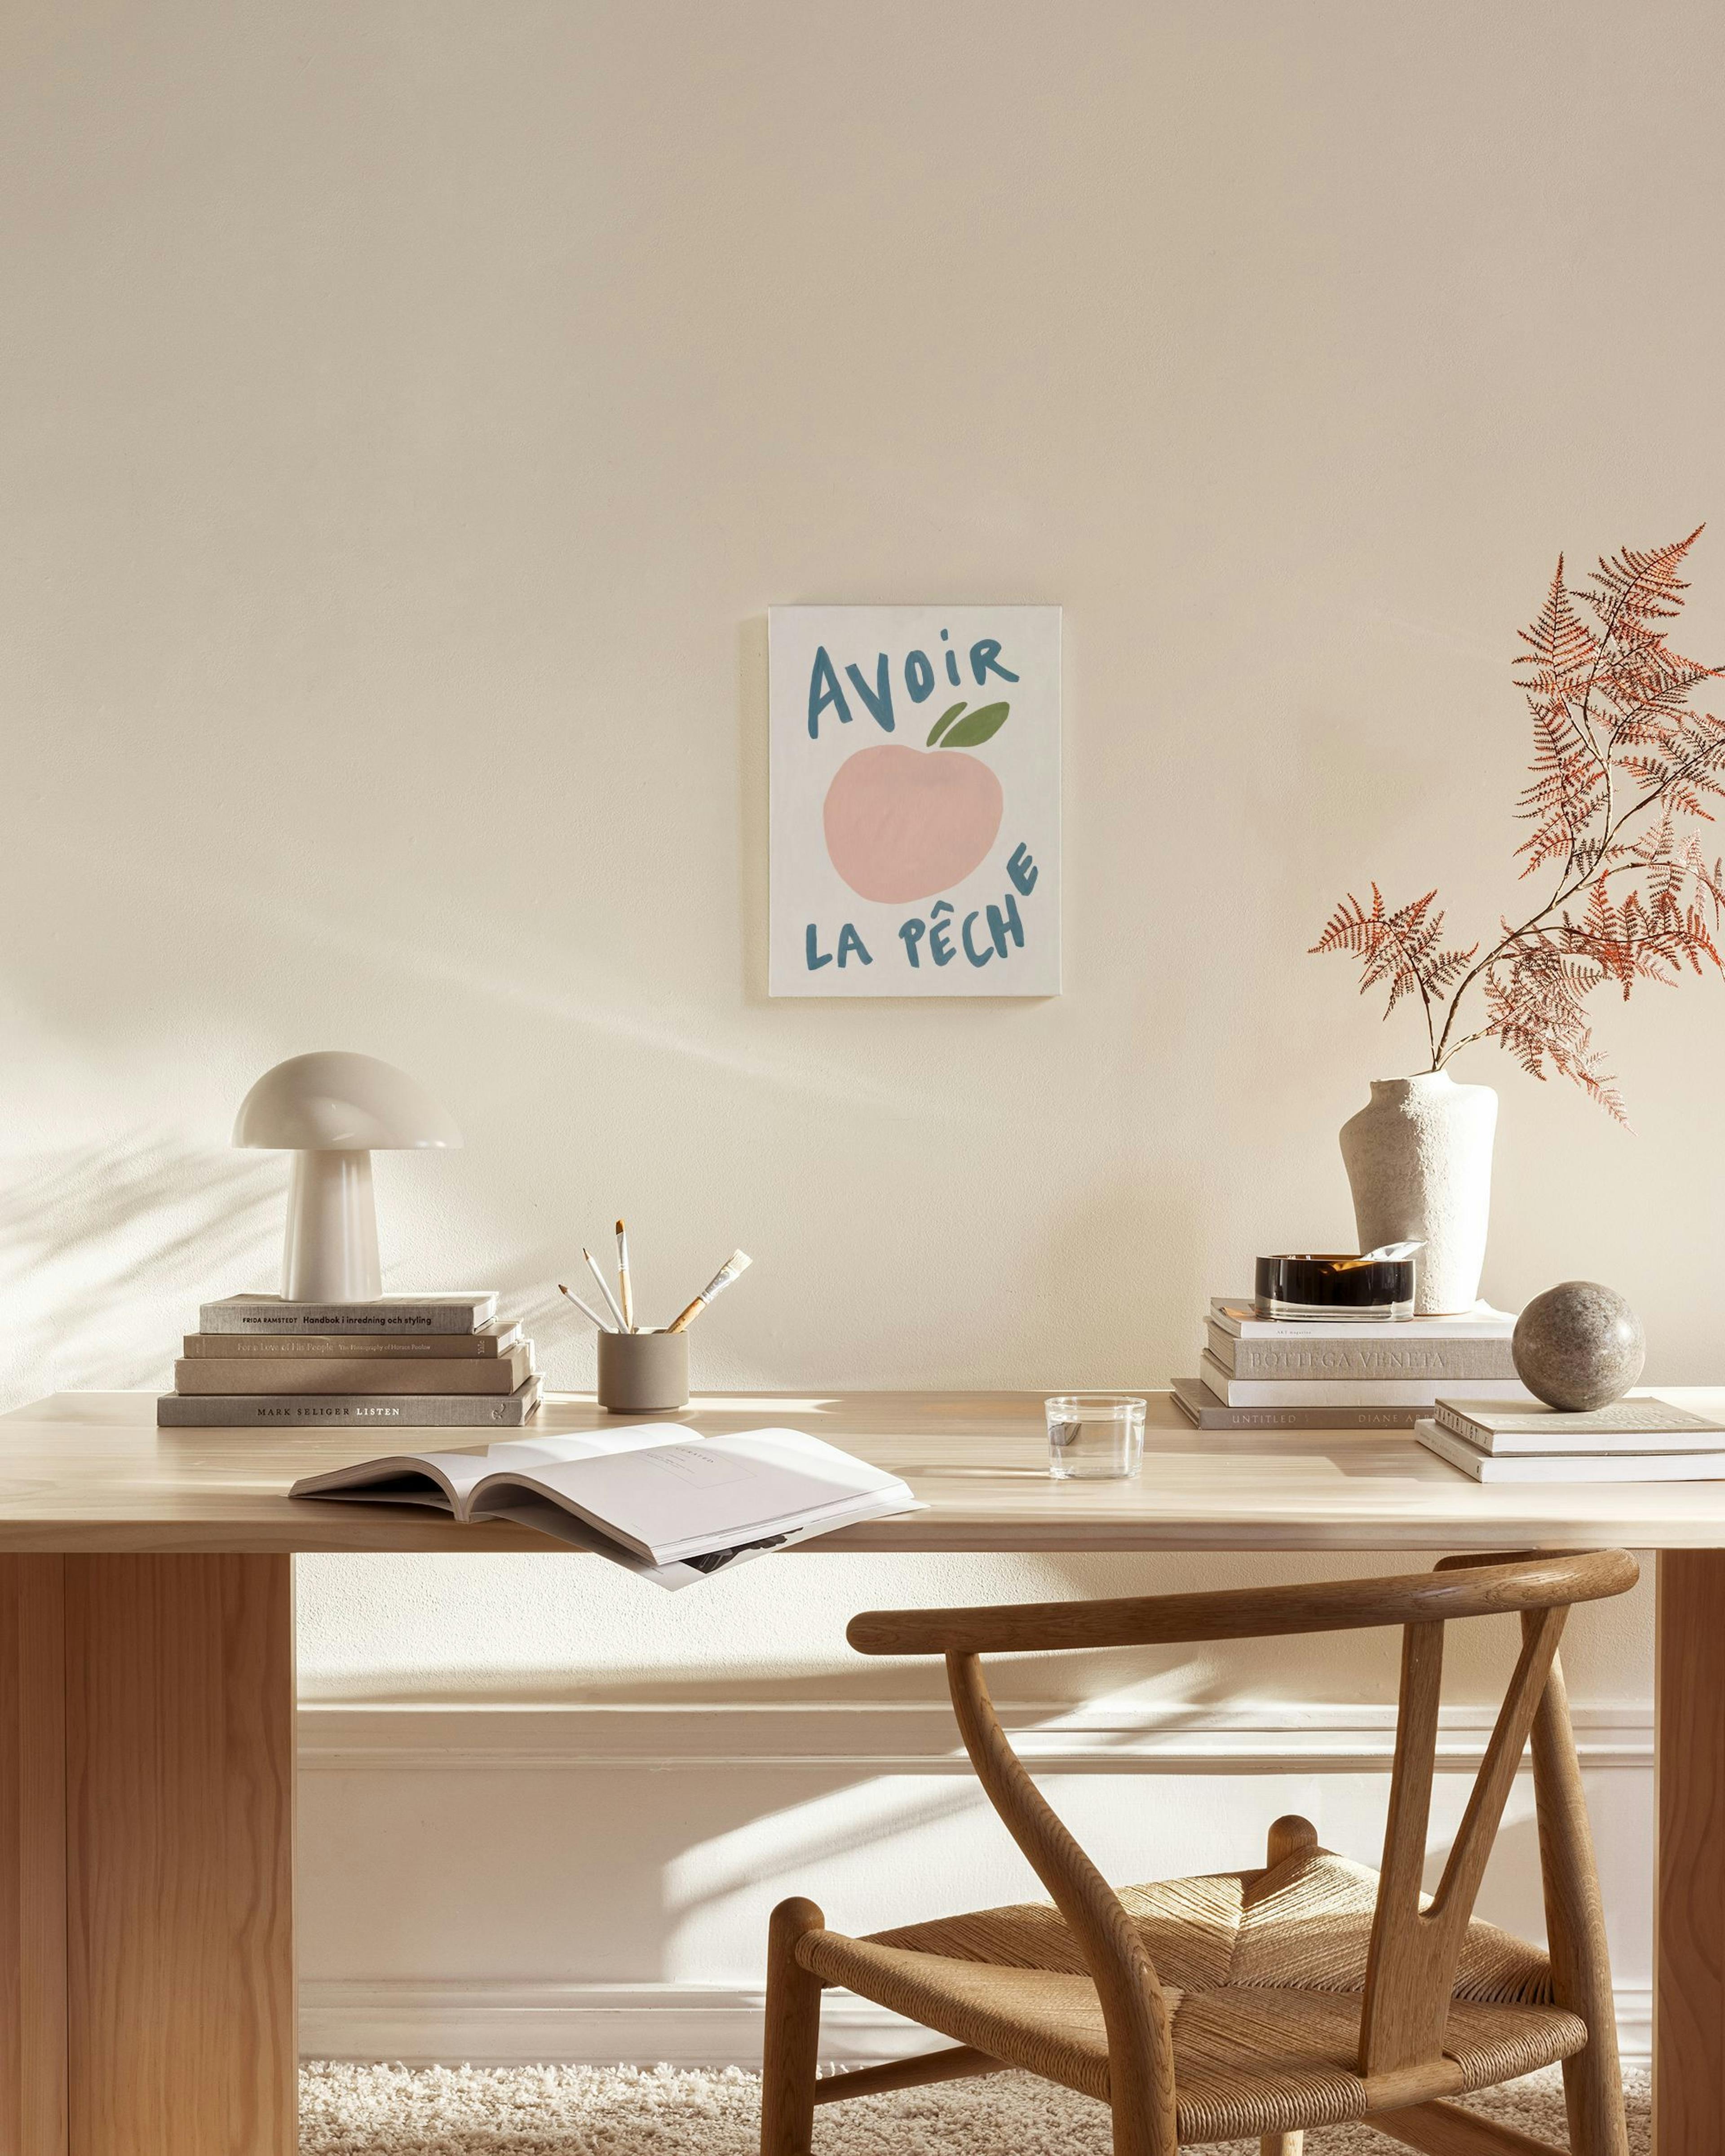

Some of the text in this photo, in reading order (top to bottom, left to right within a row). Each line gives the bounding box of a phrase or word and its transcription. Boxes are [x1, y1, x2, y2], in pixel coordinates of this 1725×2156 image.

[806, 842, 1038, 970] LA PÊCHE
[346, 1316, 385, 1325] inredning
[404, 1316, 432, 1325] styling
[1250, 1352, 1446, 1367] BOTTEGA VENETA
[356, 1408, 400, 1416] LISTEN
[1232, 1415, 1296, 1423] UNTITLED
[1358, 1414, 1398, 1423] DIANE
